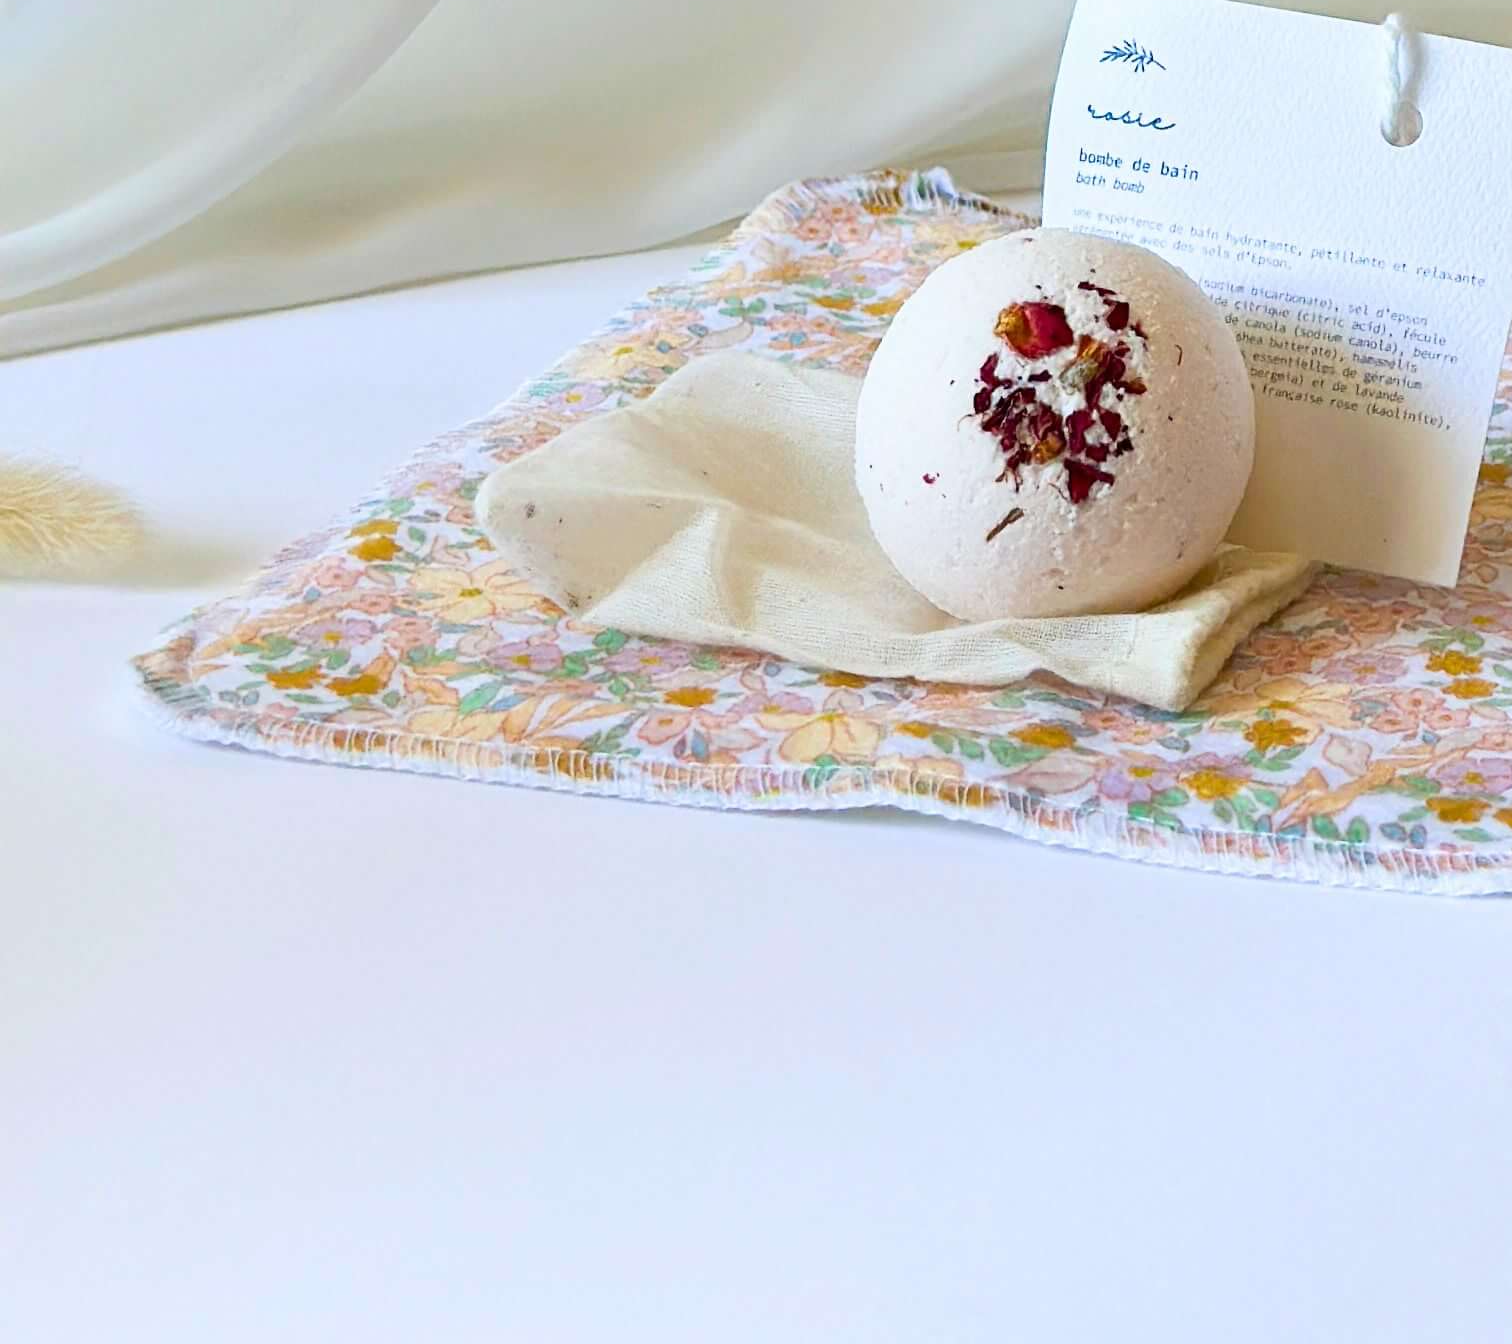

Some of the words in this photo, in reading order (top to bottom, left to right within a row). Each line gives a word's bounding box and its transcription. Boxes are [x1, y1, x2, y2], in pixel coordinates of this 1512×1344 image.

[1087, 104, 1176, 130] rosie
[1079, 147, 1123, 169] bombe
[1132, 157, 1151, 173] de
[1160, 161, 1199, 181] bain
[1076, 171, 1106, 186] bath
[1113, 179, 1145, 194] bomb
[1169, 222, 1184, 235] de
[1393, 262, 1408, 273] et
[1416, 265, 1486, 287] relaxante
[1224, 312, 1239, 325] de
[1342, 366, 1357, 378] de
[1329, 398, 1358, 411] rose
